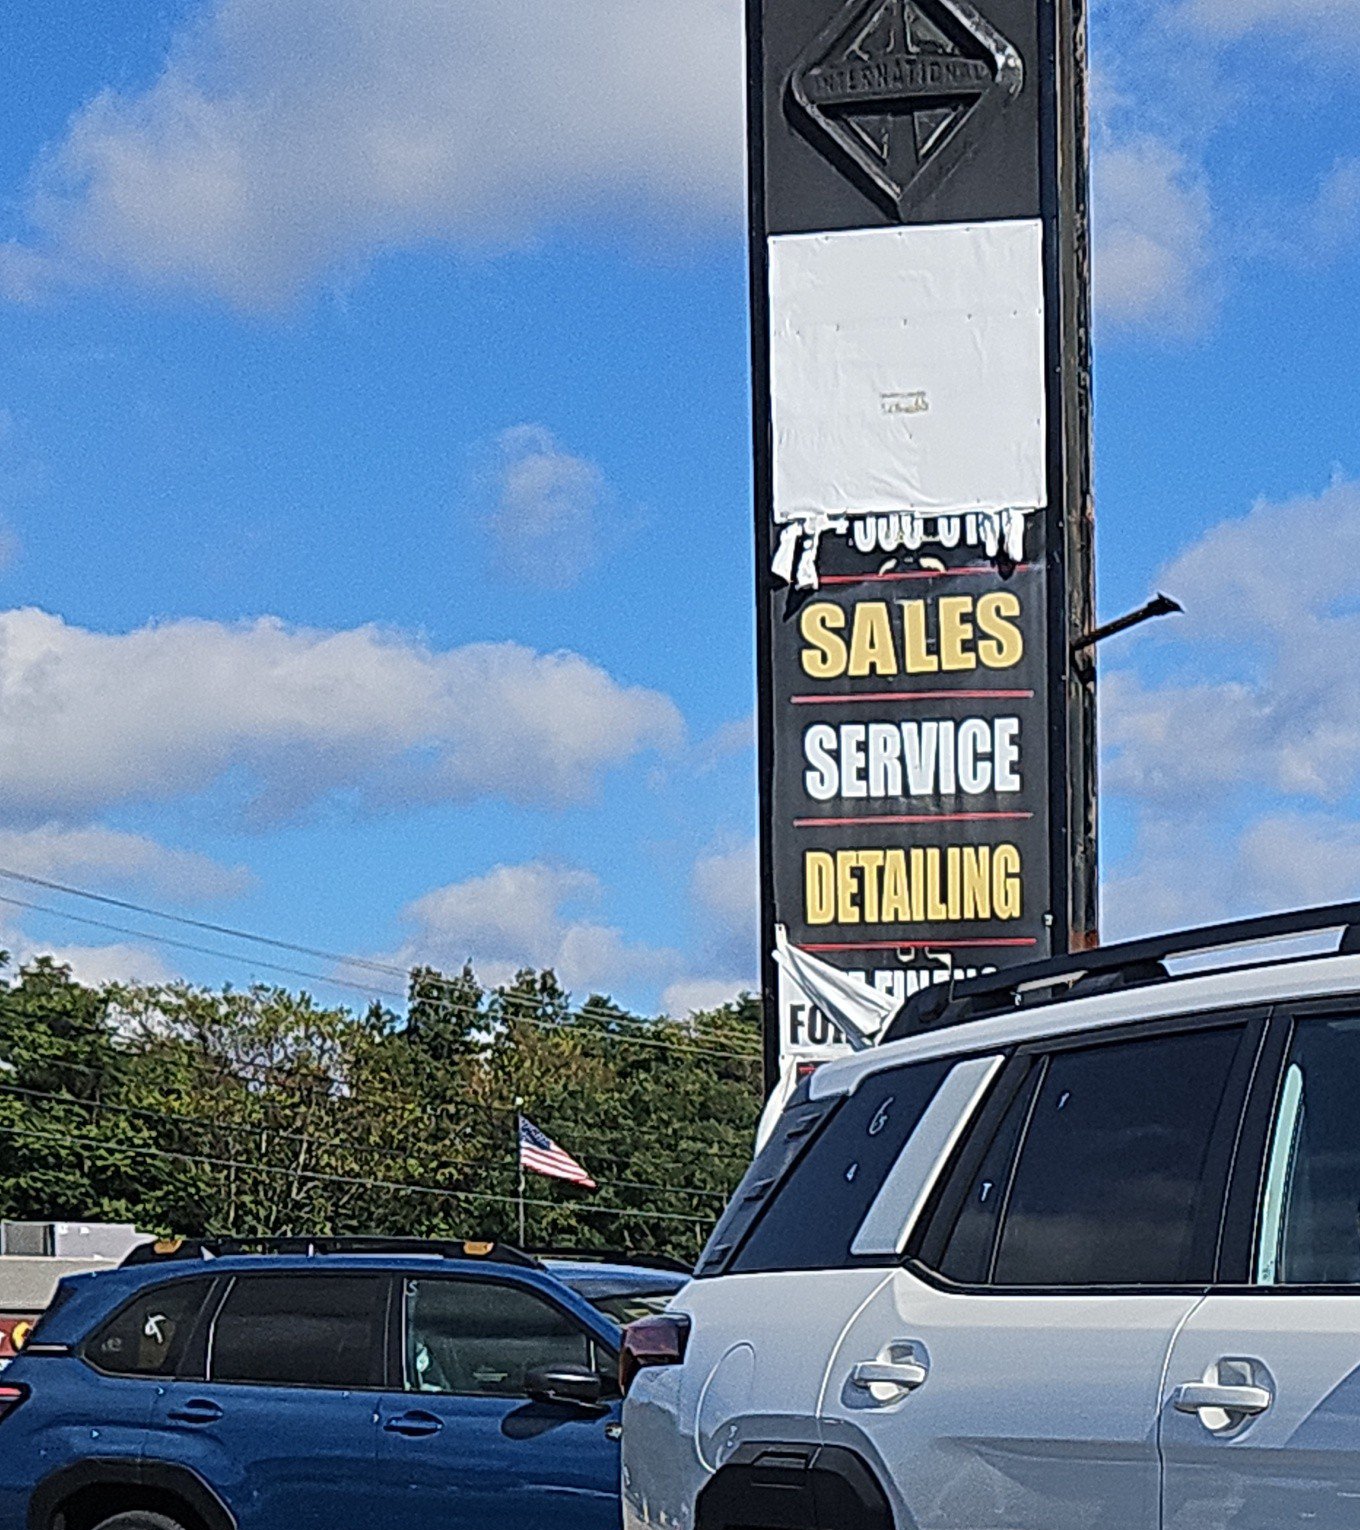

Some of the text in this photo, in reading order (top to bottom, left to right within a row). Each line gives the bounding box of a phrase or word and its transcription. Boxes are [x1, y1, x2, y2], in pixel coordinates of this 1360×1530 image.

[801, 592, 1023, 678] SALES
[804, 717, 1021, 800] SERVICE
[805, 844, 1021, 925] DETAILING
